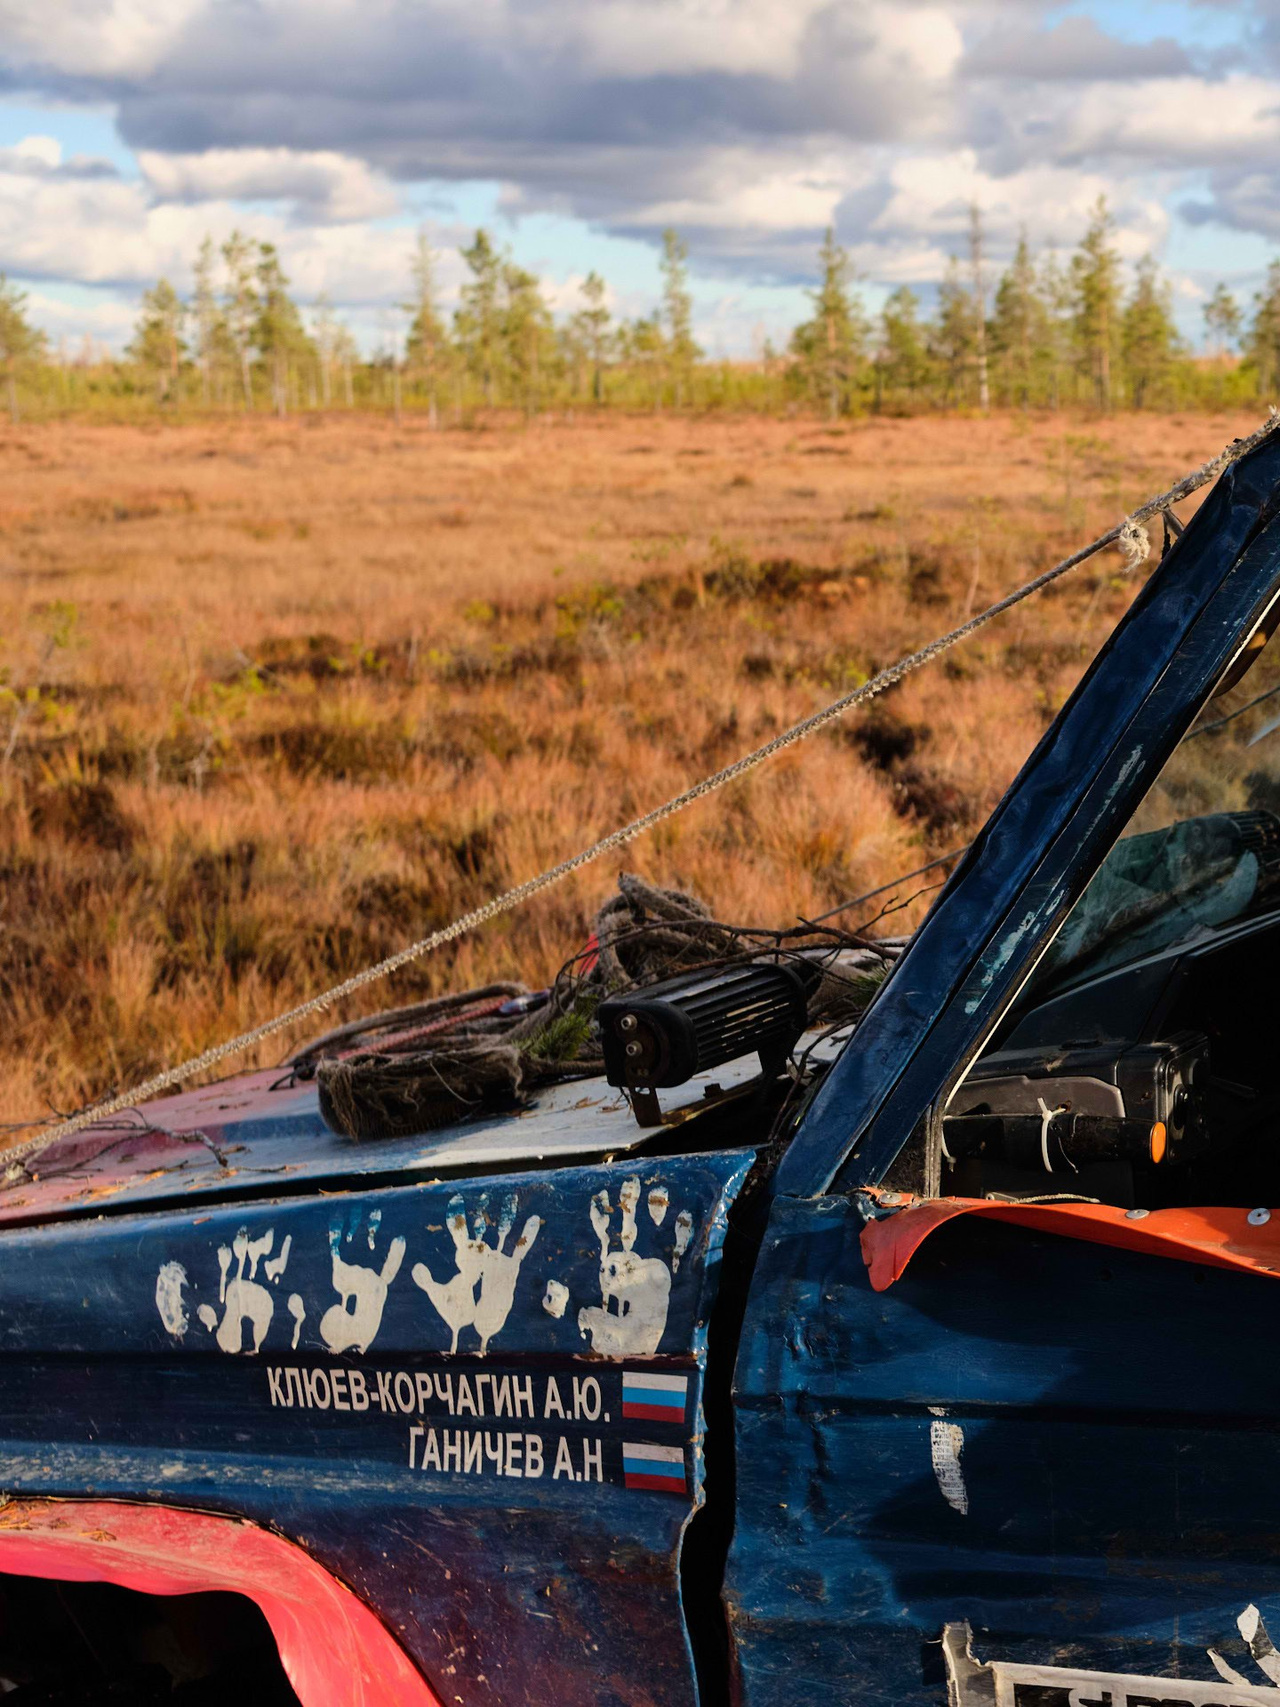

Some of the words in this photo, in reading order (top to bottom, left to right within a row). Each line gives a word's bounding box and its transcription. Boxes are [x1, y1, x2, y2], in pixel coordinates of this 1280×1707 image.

[266, 1366, 535, 1418] КЛЮЕВ-КОРЧАГИН
[543, 1374, 611, 1422] А.Ю.
[408, 1426, 544, 1479] ГАНИЧЕВ
